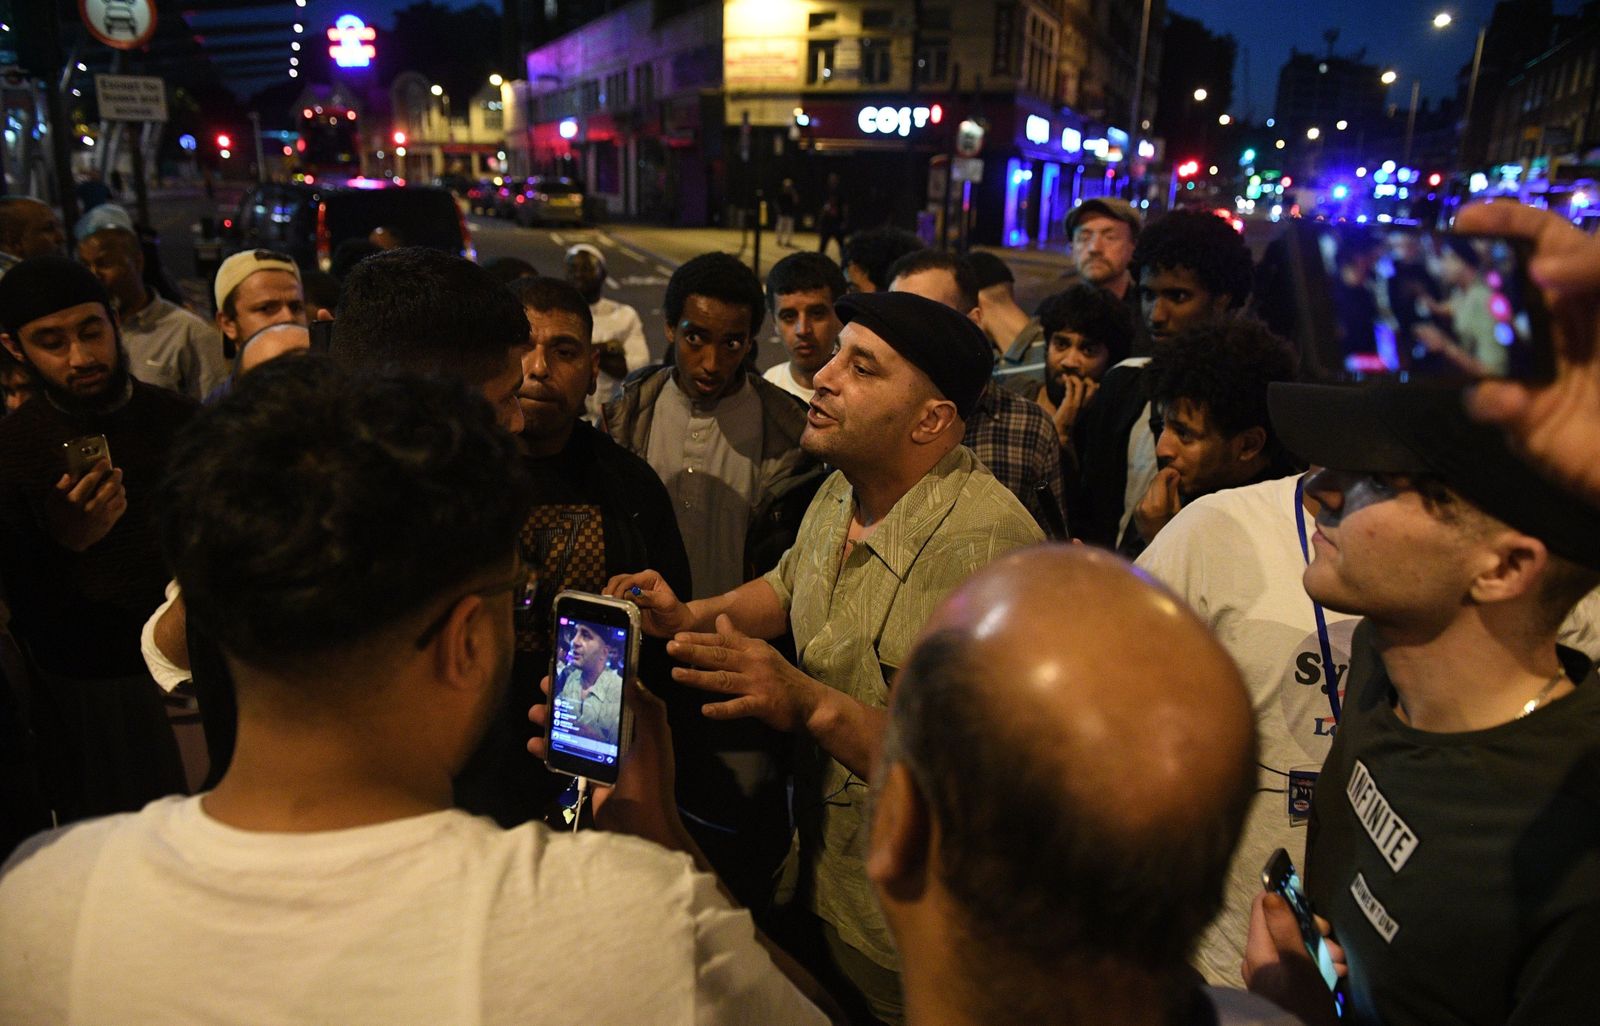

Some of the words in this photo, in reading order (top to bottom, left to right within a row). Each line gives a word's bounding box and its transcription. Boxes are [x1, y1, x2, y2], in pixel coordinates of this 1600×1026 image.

[858, 105, 942, 136] COST
[1349, 765, 1412, 864] INFINITE
[1354, 878, 1395, 937] MOMENTUM
